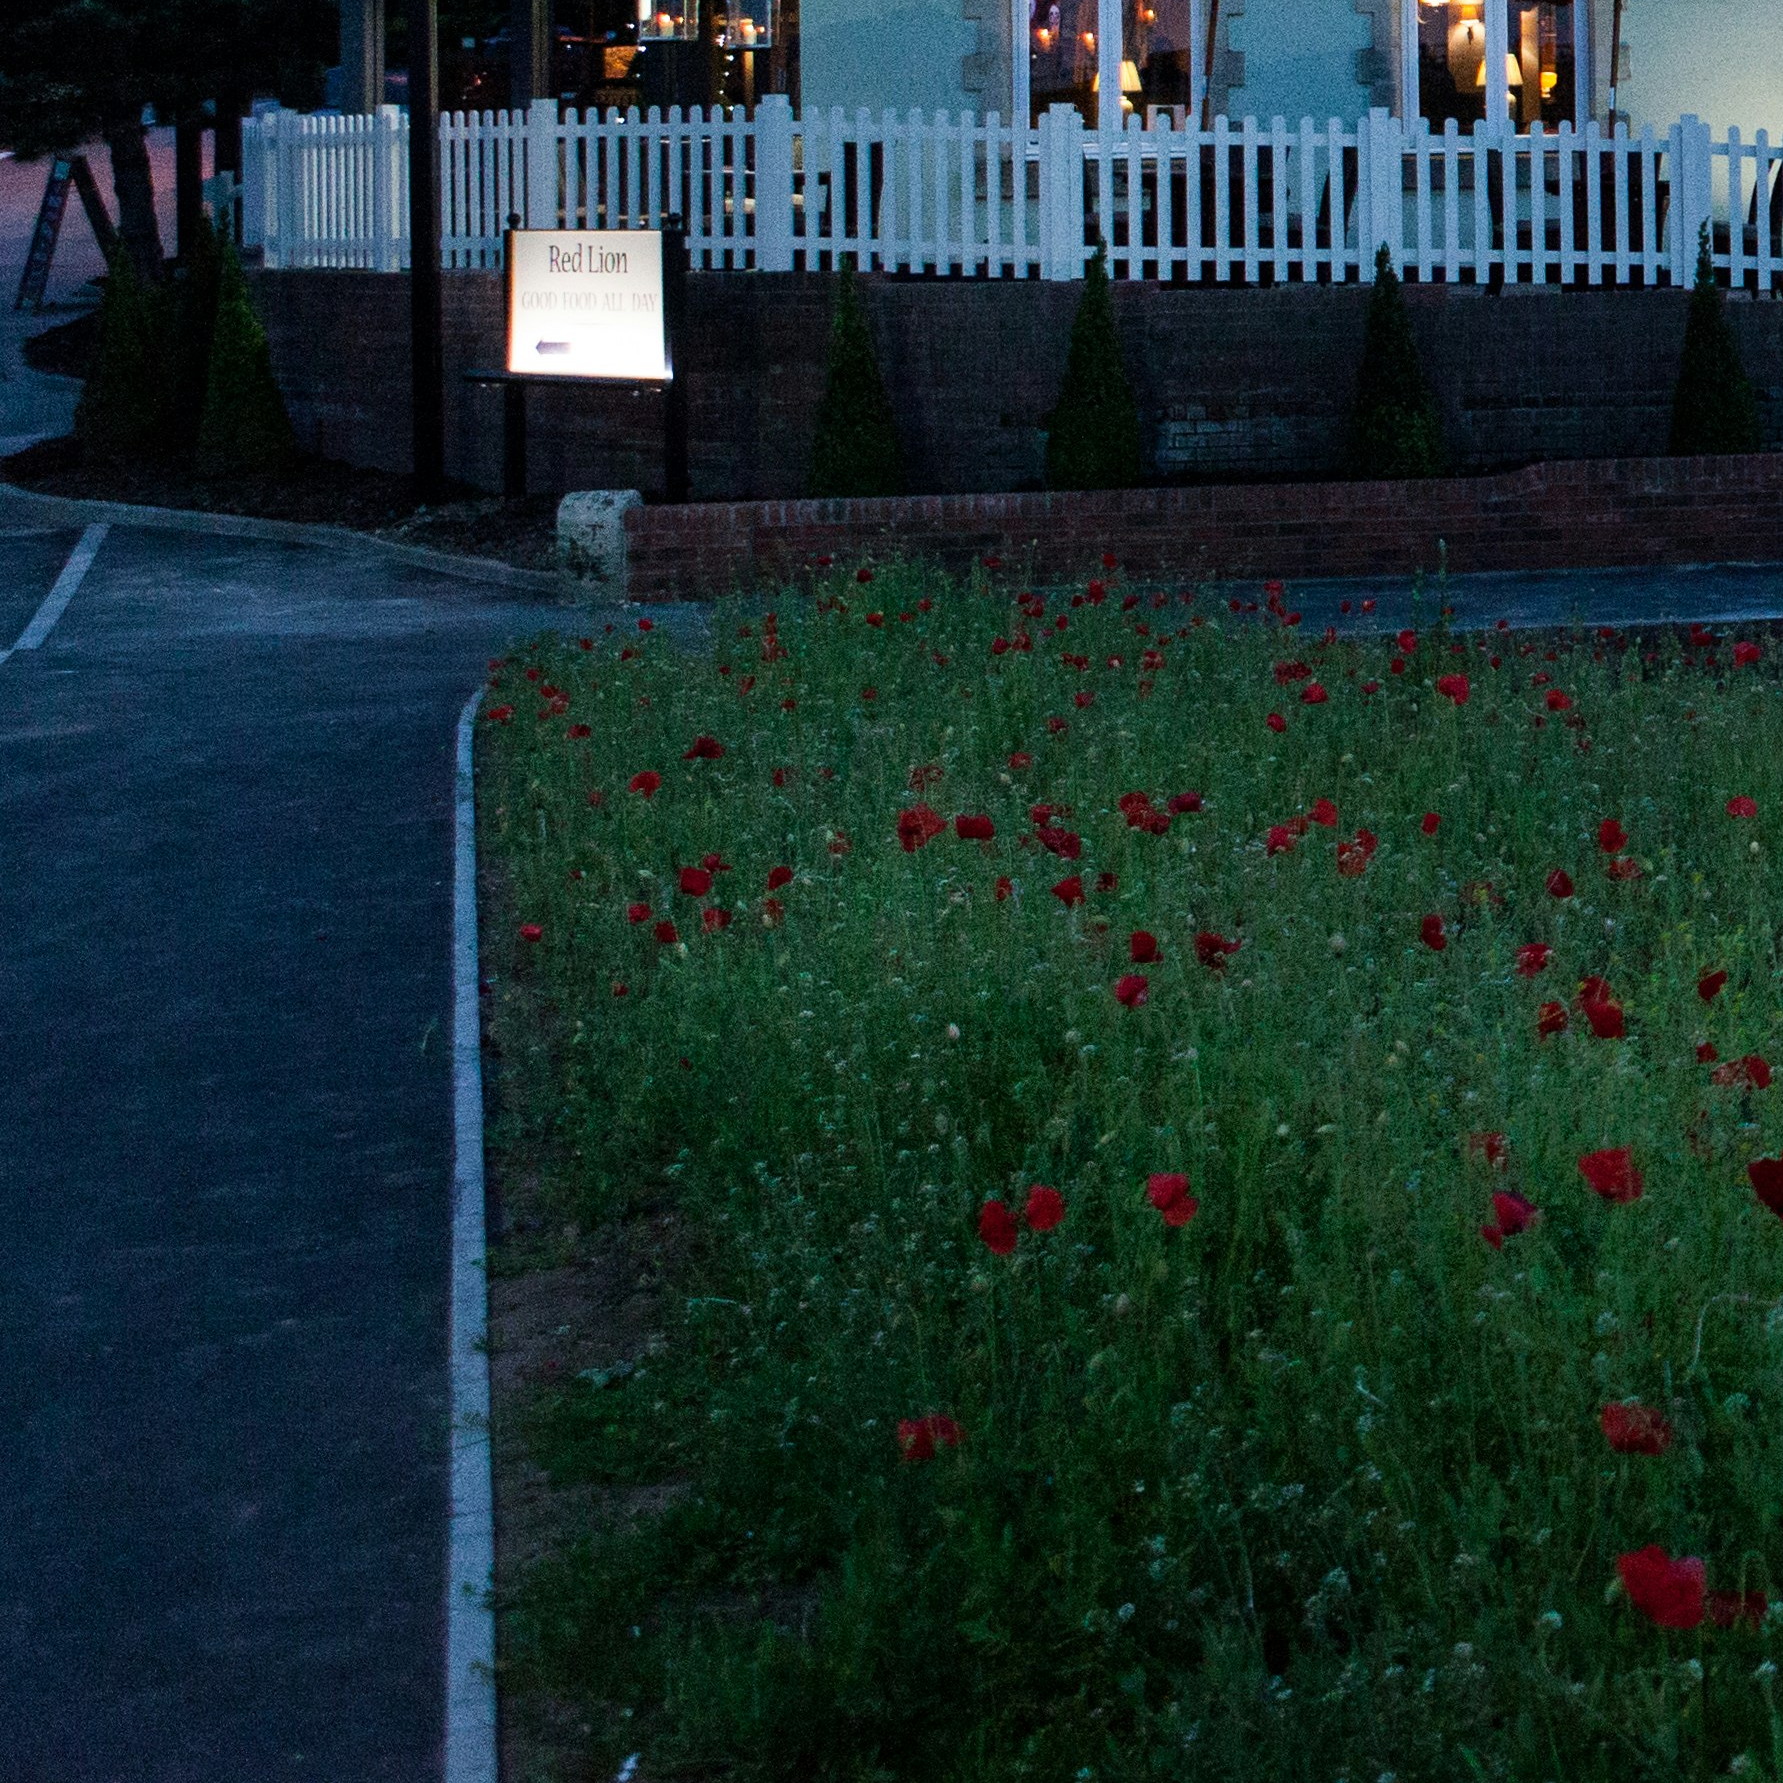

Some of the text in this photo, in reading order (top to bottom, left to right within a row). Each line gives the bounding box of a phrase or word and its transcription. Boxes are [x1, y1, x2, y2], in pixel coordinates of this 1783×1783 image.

[549, 243, 629, 274] Red Lion
[521, 290, 658, 313] GOOD FOOD ALL DAY
